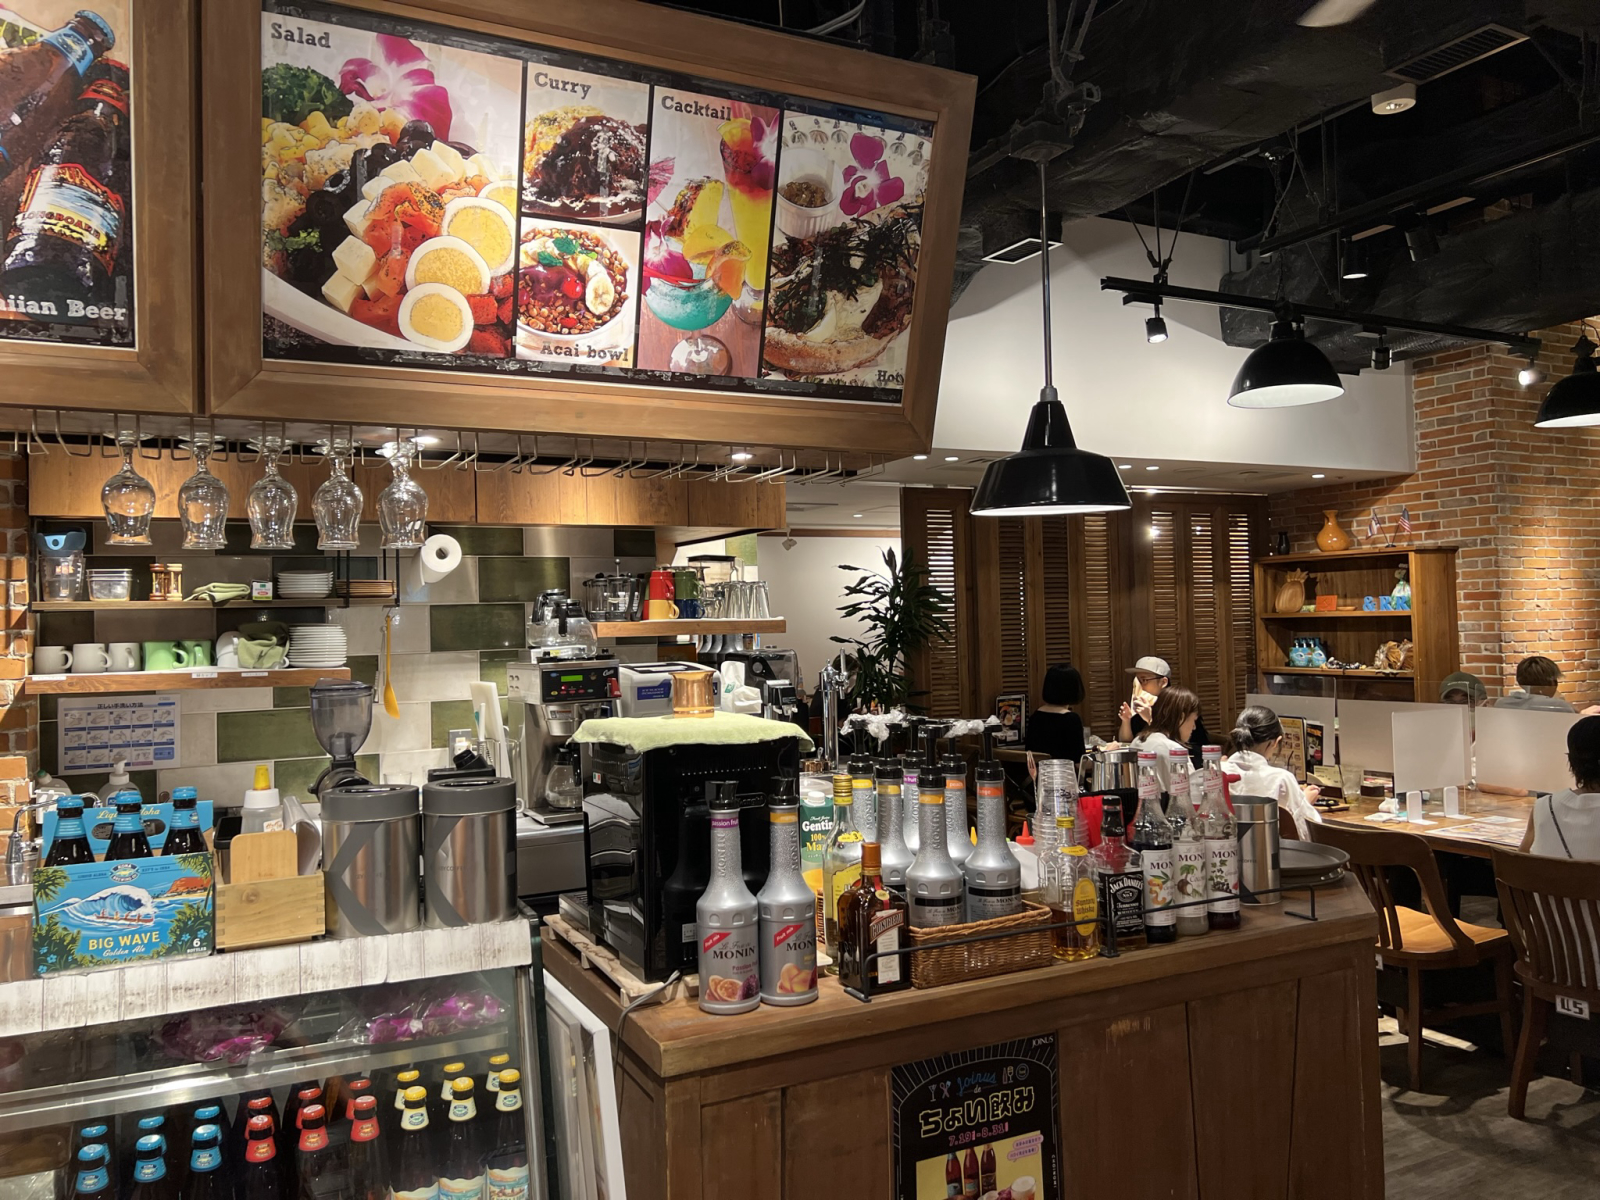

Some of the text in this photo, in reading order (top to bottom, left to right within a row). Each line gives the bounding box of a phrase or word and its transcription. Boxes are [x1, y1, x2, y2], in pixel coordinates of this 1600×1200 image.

[271, 22, 331, 48] Salad
[534, 72, 592, 99] Curry
[661, 95, 732, 121] Cacktail
[66, 299, 127, 320] Beer
[540, 341, 629, 361] Acai bowl
[97, 702, 144, 710] 正しい手洗い方法
[716, 832, 726, 878] MONIN
[1110, 880, 1125, 893] JACK
[1075, 898, 1095, 907] Suntory
[1076, 905, 1095, 915] Whisky
[88, 931, 160, 950] BIG WAVE
[193, 938, 201, 947] 6
[102, 945, 146, 957] Golden Ale
[713, 946, 755, 959] MONIN
[1031, 1036, 1054, 1048] JOINUS
[957, 1071, 997, 1097] Joinus
[973, 1085, 982, 1094] de
[919, 1086, 1035, 1138] ちょい飲み
